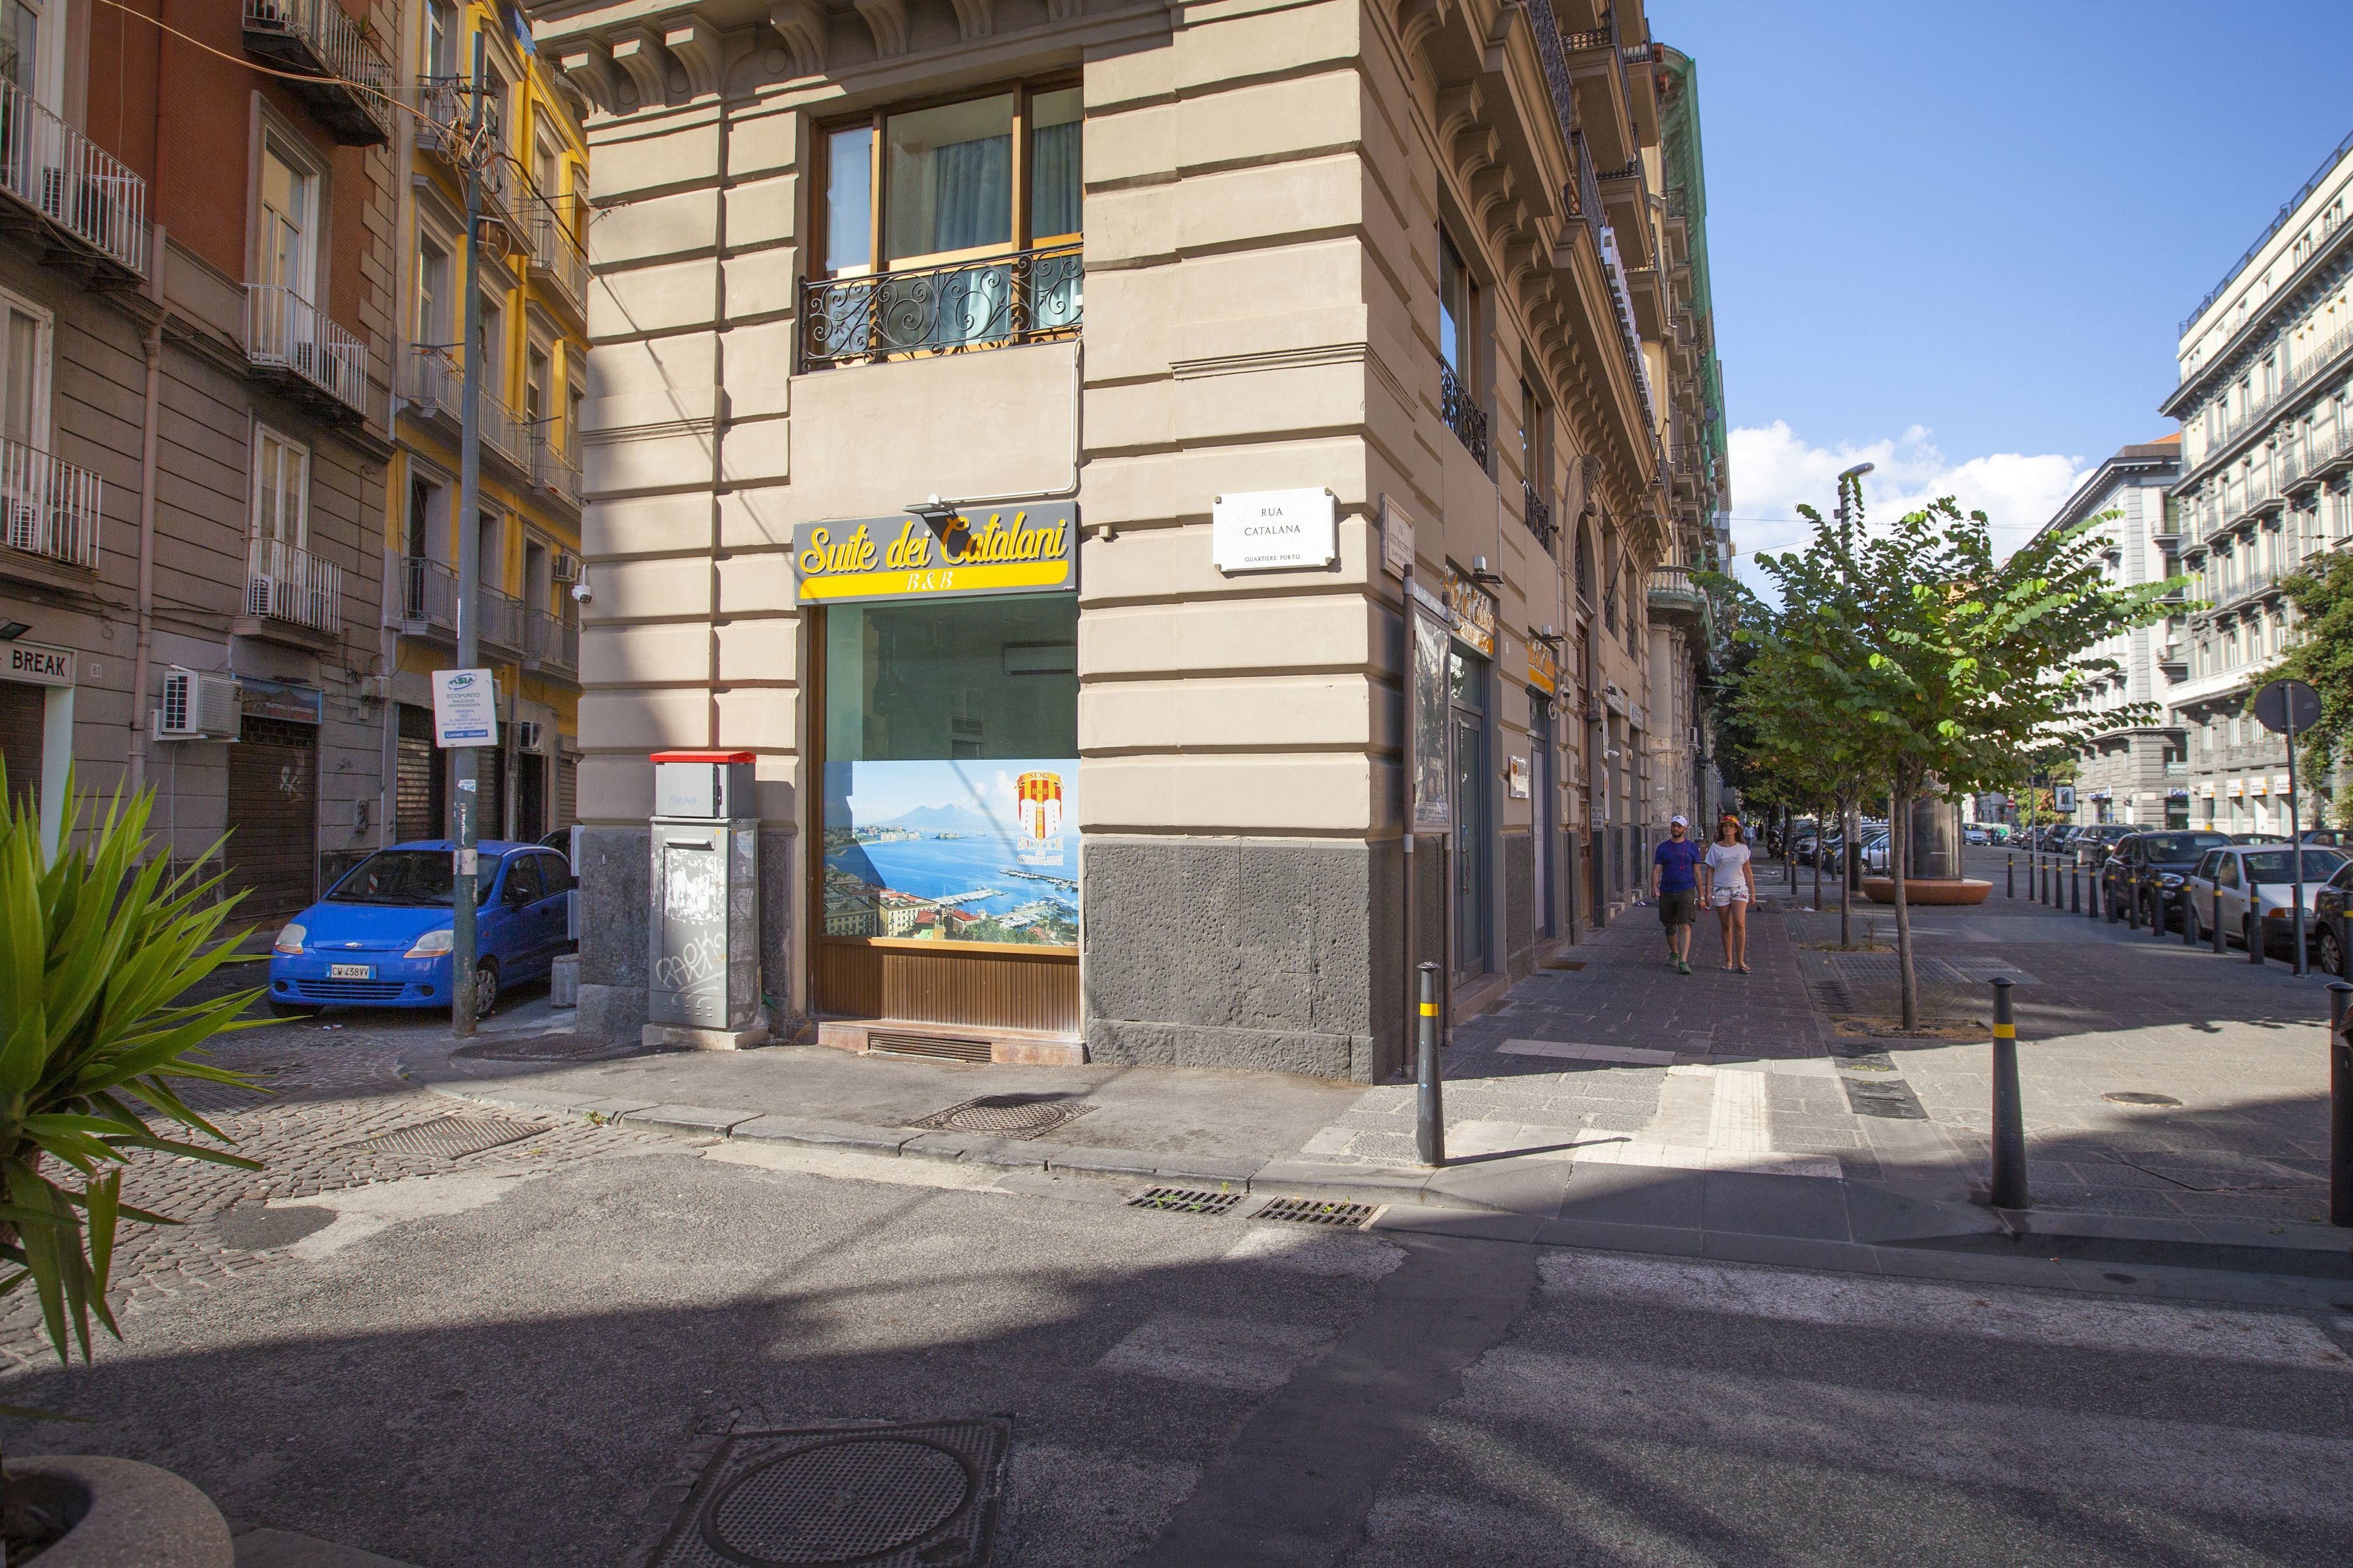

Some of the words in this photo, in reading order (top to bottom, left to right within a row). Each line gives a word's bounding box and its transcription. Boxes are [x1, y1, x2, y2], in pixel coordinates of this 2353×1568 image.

[1261, 508, 1282, 516] RUA
[1244, 525, 1300, 536] CATALANA
[799, 524, 878, 574] Suite
[886, 521, 932, 569] dei
[941, 511, 1068, 565] Catalani
[12, 649, 66, 677] BREAK
[92, 665, 101, 676] 81
[1018, 836, 1064, 850] SUITE
[1018, 855, 1064, 865] CATALANI
